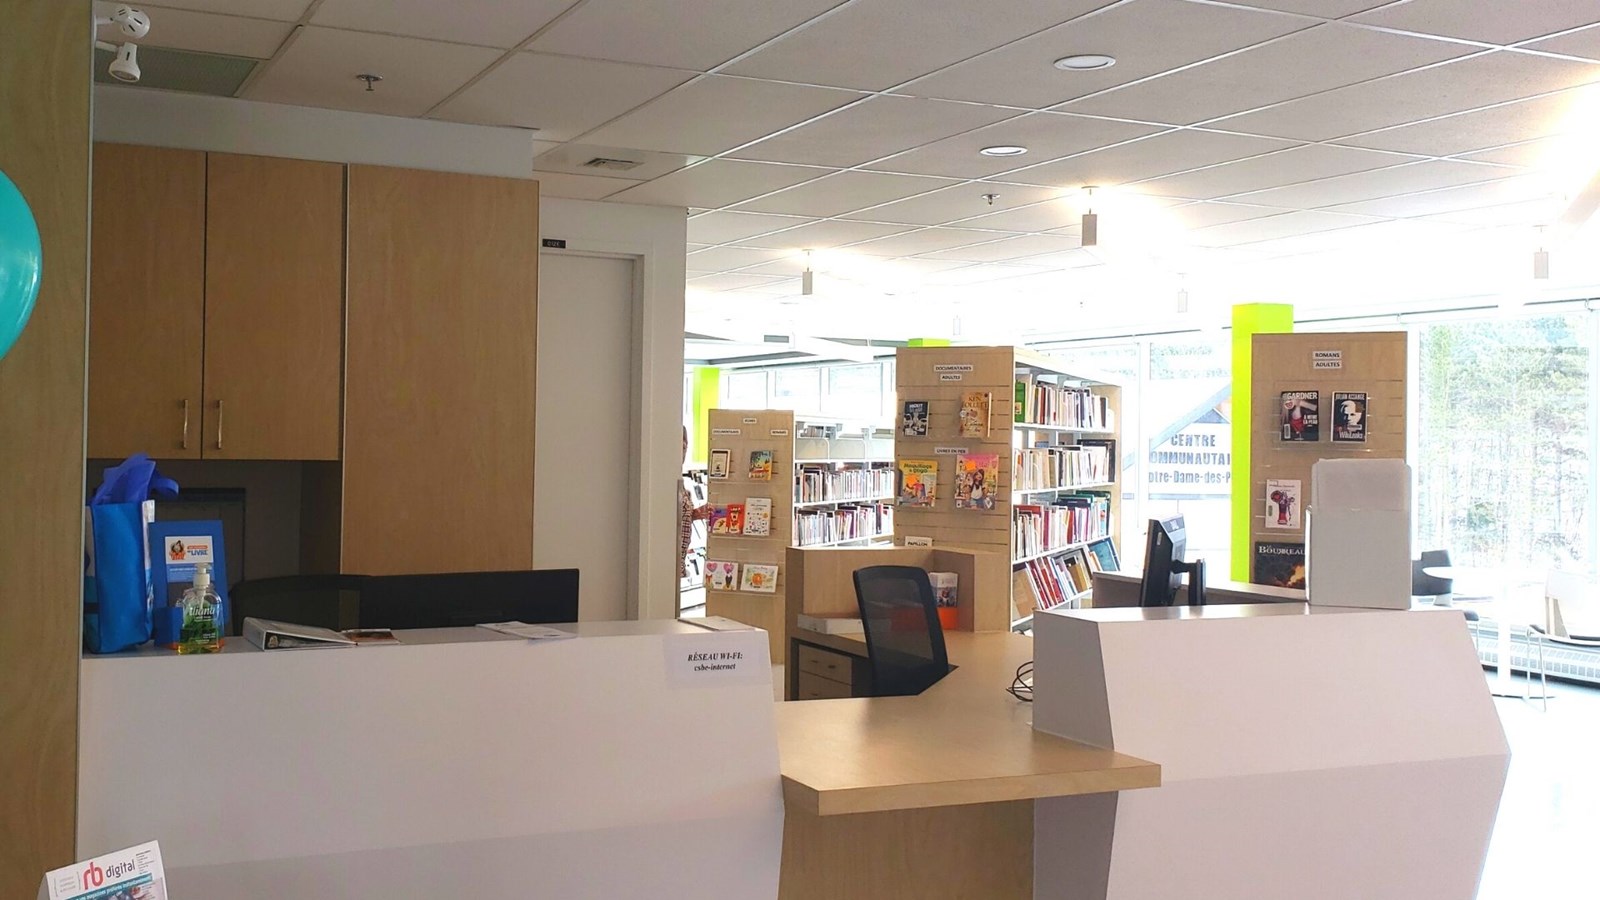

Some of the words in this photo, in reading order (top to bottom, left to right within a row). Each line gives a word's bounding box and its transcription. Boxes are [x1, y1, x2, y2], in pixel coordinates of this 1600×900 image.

[1287, 392, 1318, 400] GARDNER
[1171, 434, 1216, 447] CENTRE
[1149, 451, 1230, 465] OMMUNAUTAI
[1148, 470, 1231, 484] otre-Dame-des-P
[688, 651, 719, 661] RÉSEAU
[720, 651, 743, 660] WI-FI:
[83, 862, 104, 890] rb
[106, 859, 136, 878] digital
